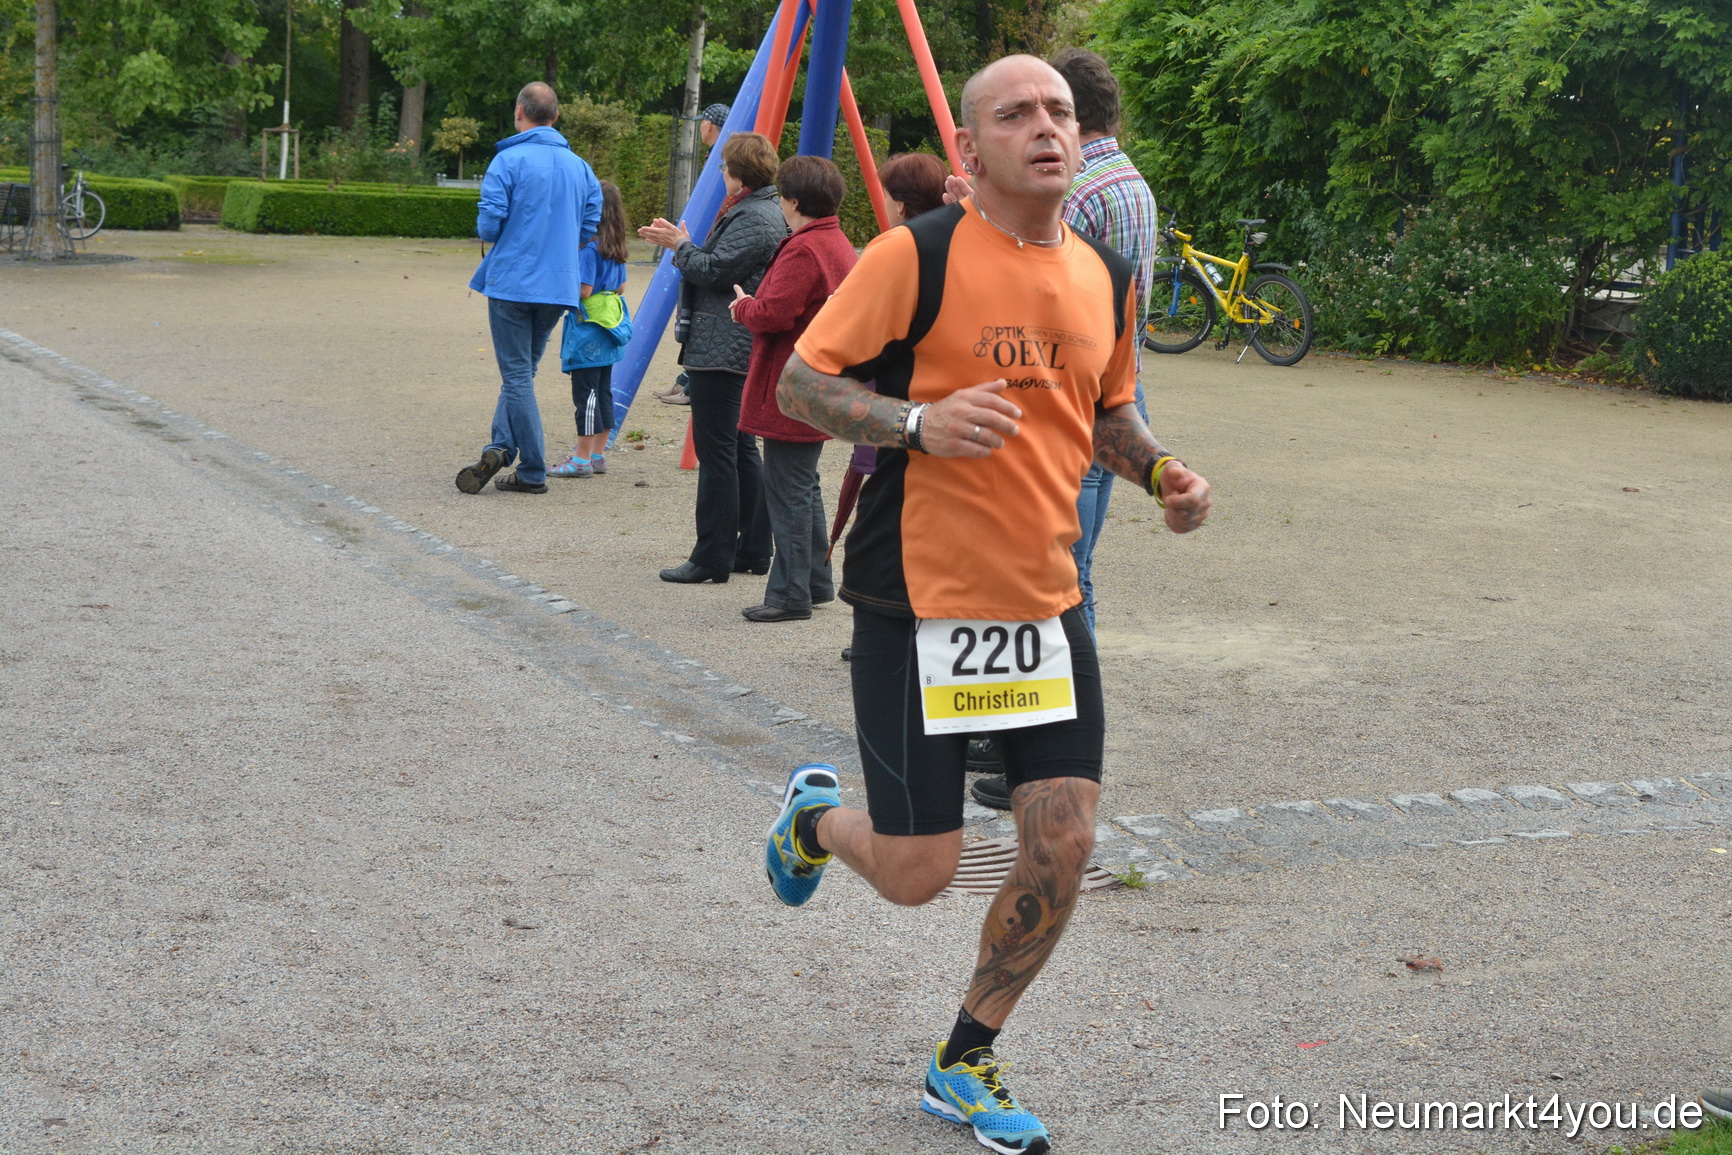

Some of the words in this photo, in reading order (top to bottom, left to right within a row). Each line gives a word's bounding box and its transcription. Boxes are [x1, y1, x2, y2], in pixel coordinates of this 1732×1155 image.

[1050, 331, 1066, 341] UND
[993, 340, 1066, 370] OEXL
[950, 623, 1041, 677] 220
[926, 676, 932, 685] B
[953, 689, 1040, 712] Christian
